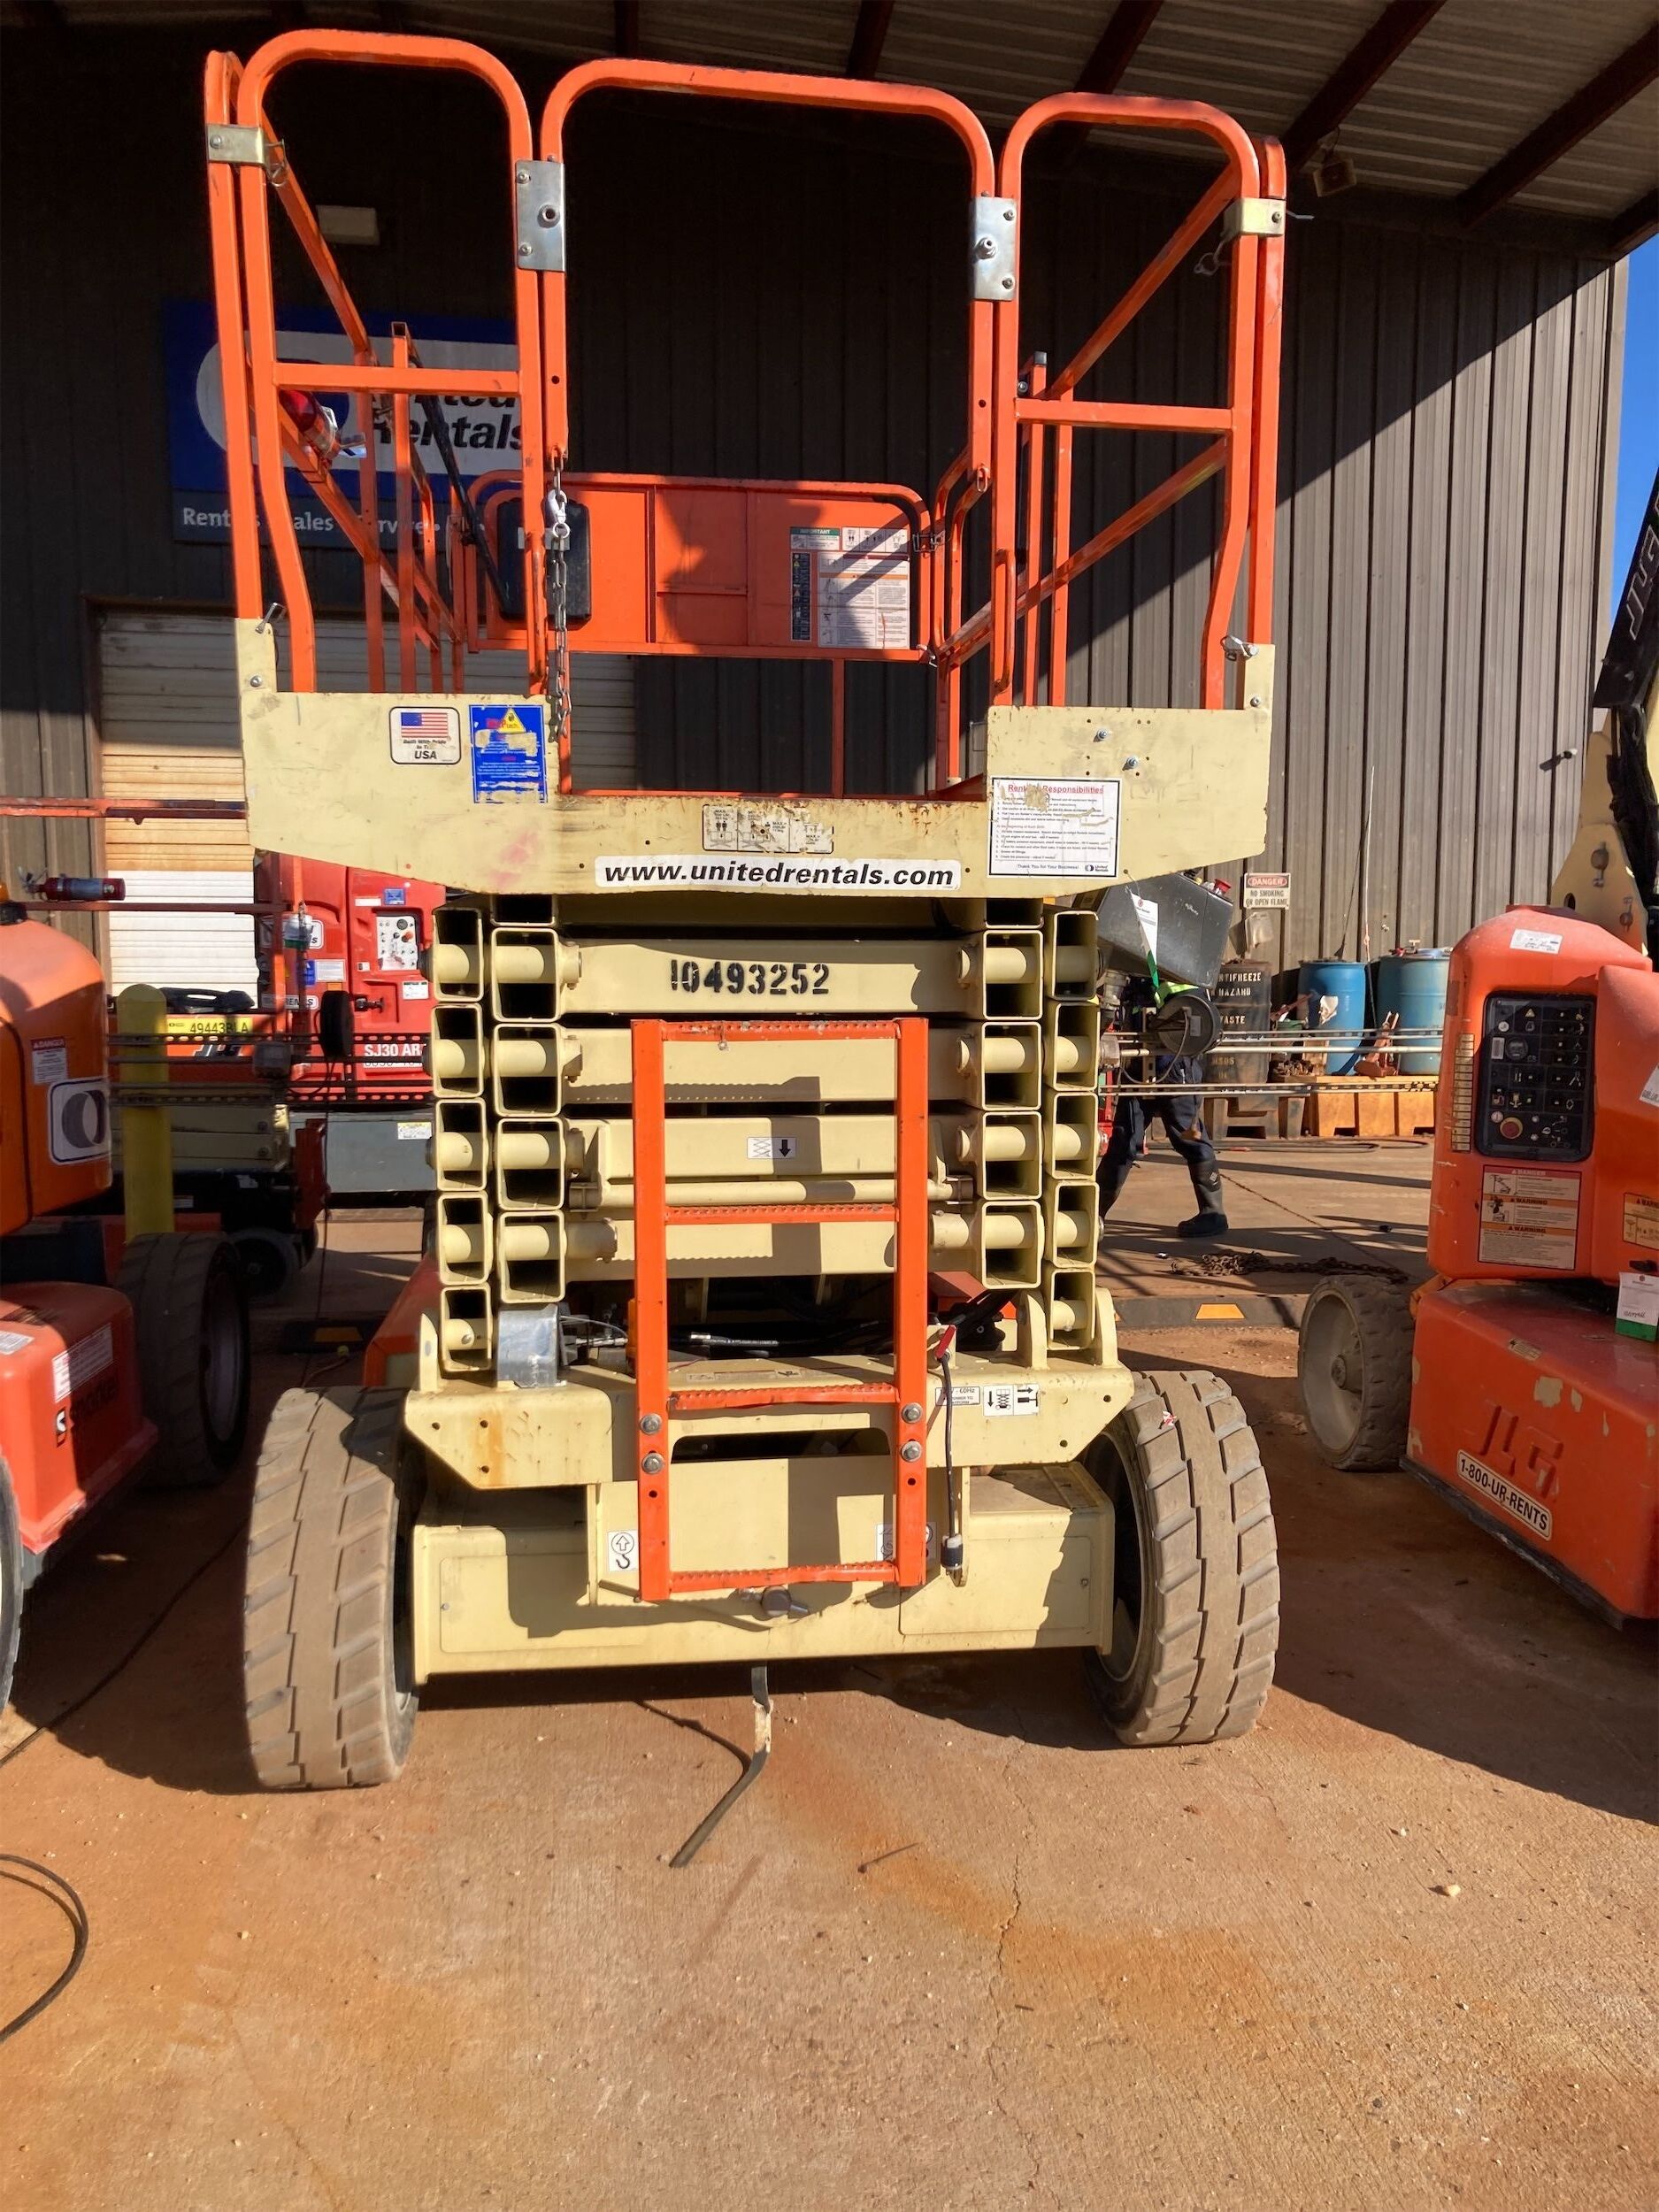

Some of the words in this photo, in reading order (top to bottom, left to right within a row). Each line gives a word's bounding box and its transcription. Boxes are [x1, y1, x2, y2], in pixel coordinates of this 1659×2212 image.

[294, 512, 334, 531] ales
[415, 750, 437, 759] USA
[1042, 785, 1103, 794] Responsibilities
[605, 861, 953, 886] www.unitedrentals.com
[671, 959, 830, 995] 10493252
[1218, 972, 1262, 982] NTIFREEZE
[365, 1044, 398, 1056] SJ30
[1463, 1399, 1564, 1499] JLG
[1460, 1458, 1548, 1531] 1-800-UR-RENTS
